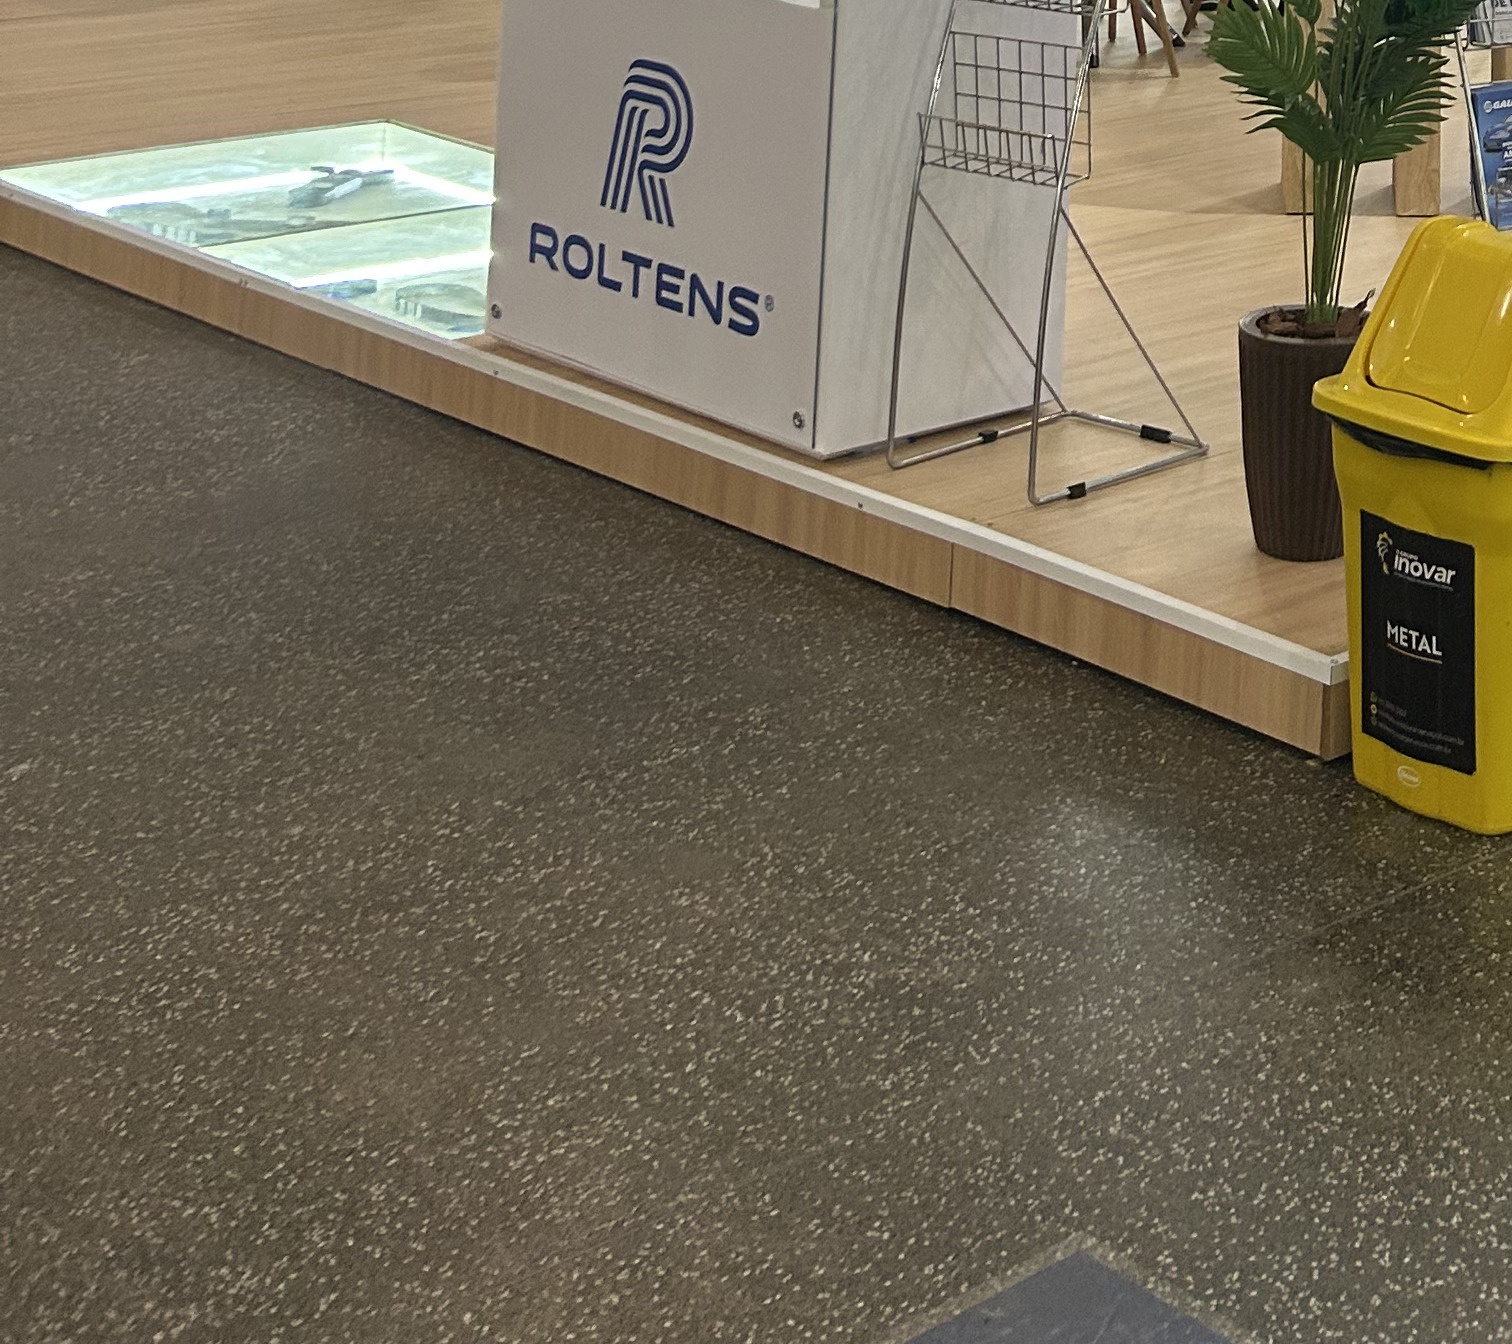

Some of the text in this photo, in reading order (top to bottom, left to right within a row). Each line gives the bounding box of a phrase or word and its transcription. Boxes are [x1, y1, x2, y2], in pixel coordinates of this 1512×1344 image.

[528, 222, 762, 338] ROLTENS
[1393, 549, 1457, 585] inovar
[1386, 619, 1443, 657] METAL
